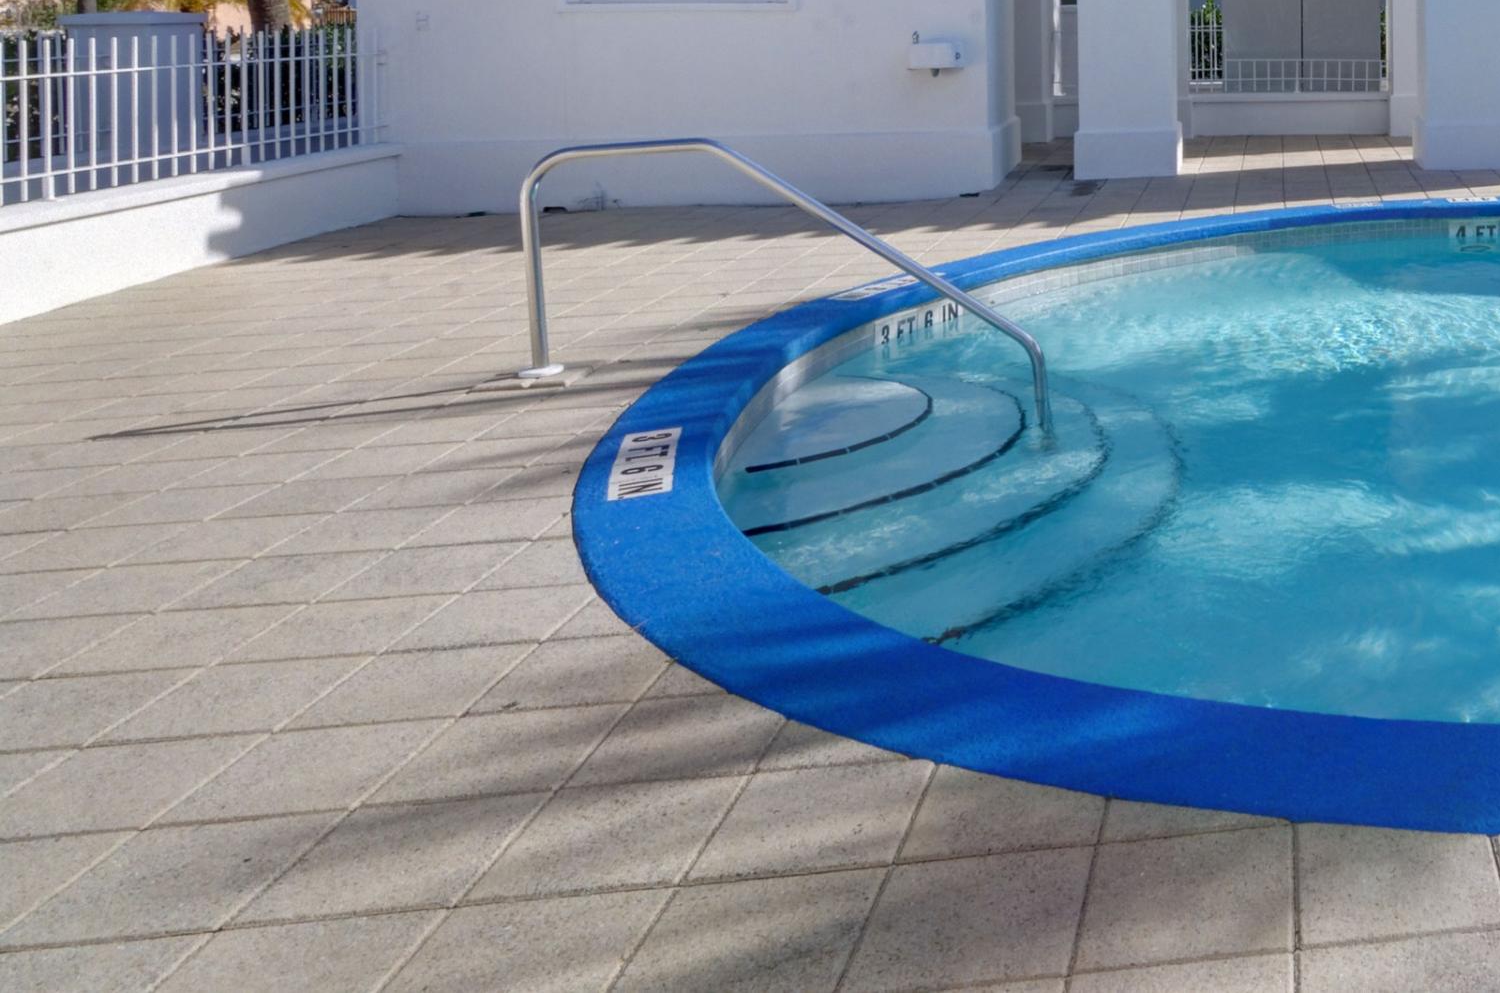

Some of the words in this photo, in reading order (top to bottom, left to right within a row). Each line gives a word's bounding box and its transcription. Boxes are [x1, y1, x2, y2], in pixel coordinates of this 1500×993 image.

[1476, 225, 1496, 237] FT
[881, 324, 890, 344] 3
[896, 316, 916, 338] FT
[942, 302, 958, 323] IN
[632, 433, 672, 442] 3
[620, 464, 664, 475] 6
